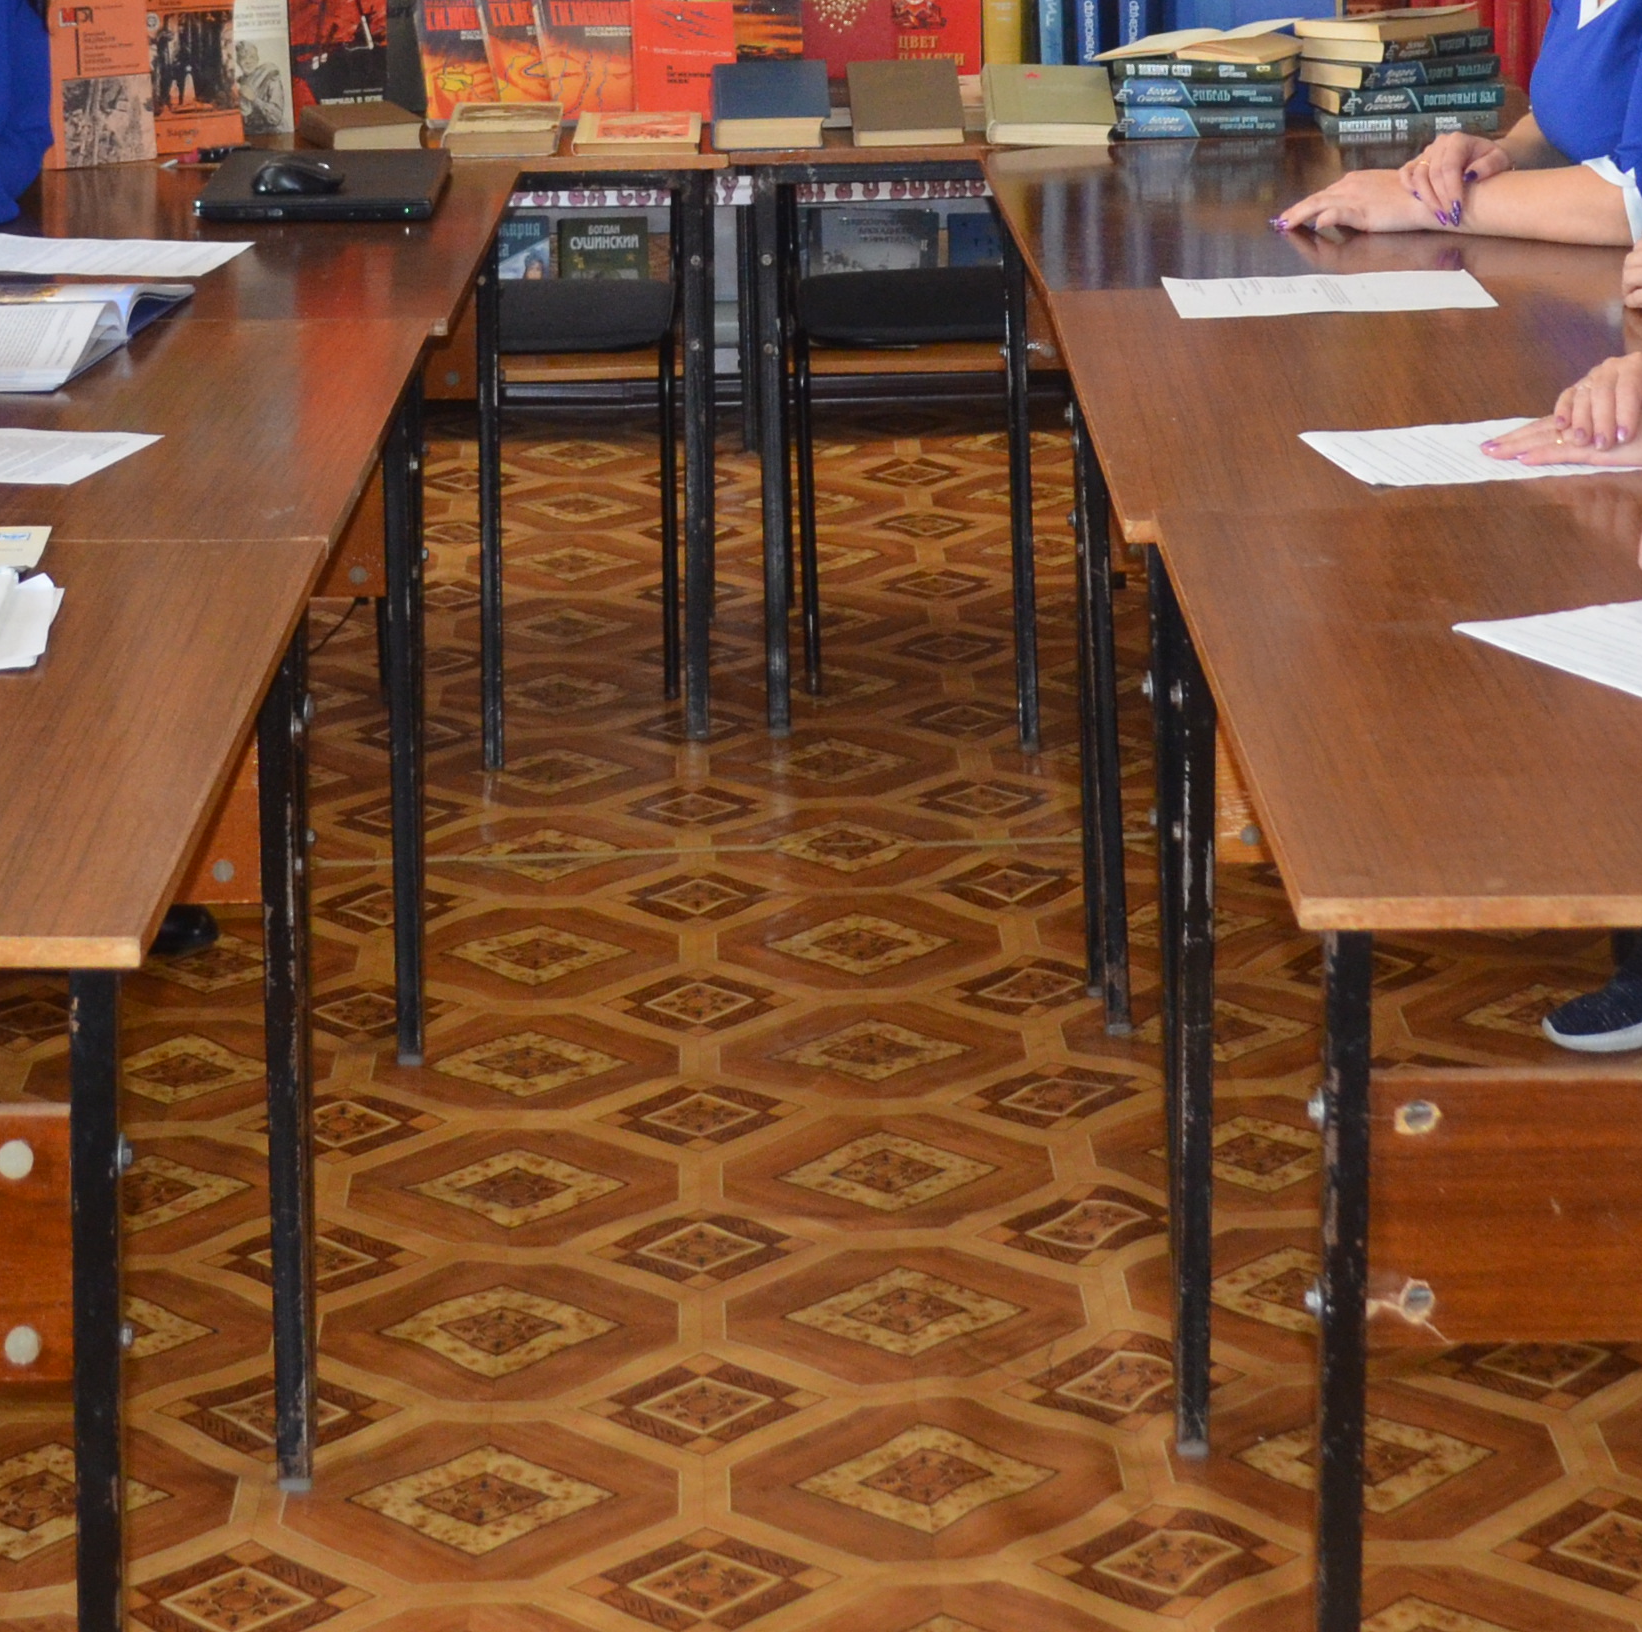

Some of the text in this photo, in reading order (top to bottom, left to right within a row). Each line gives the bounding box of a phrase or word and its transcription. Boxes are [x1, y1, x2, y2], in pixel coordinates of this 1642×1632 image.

[1083, 0, 1095, 62] Александр
[898, 35, 939, 49] ЦВЕТ
[588, 223, 621, 235] БОГДАН
[570, 234, 640, 250] СУШИНСКИЙ
